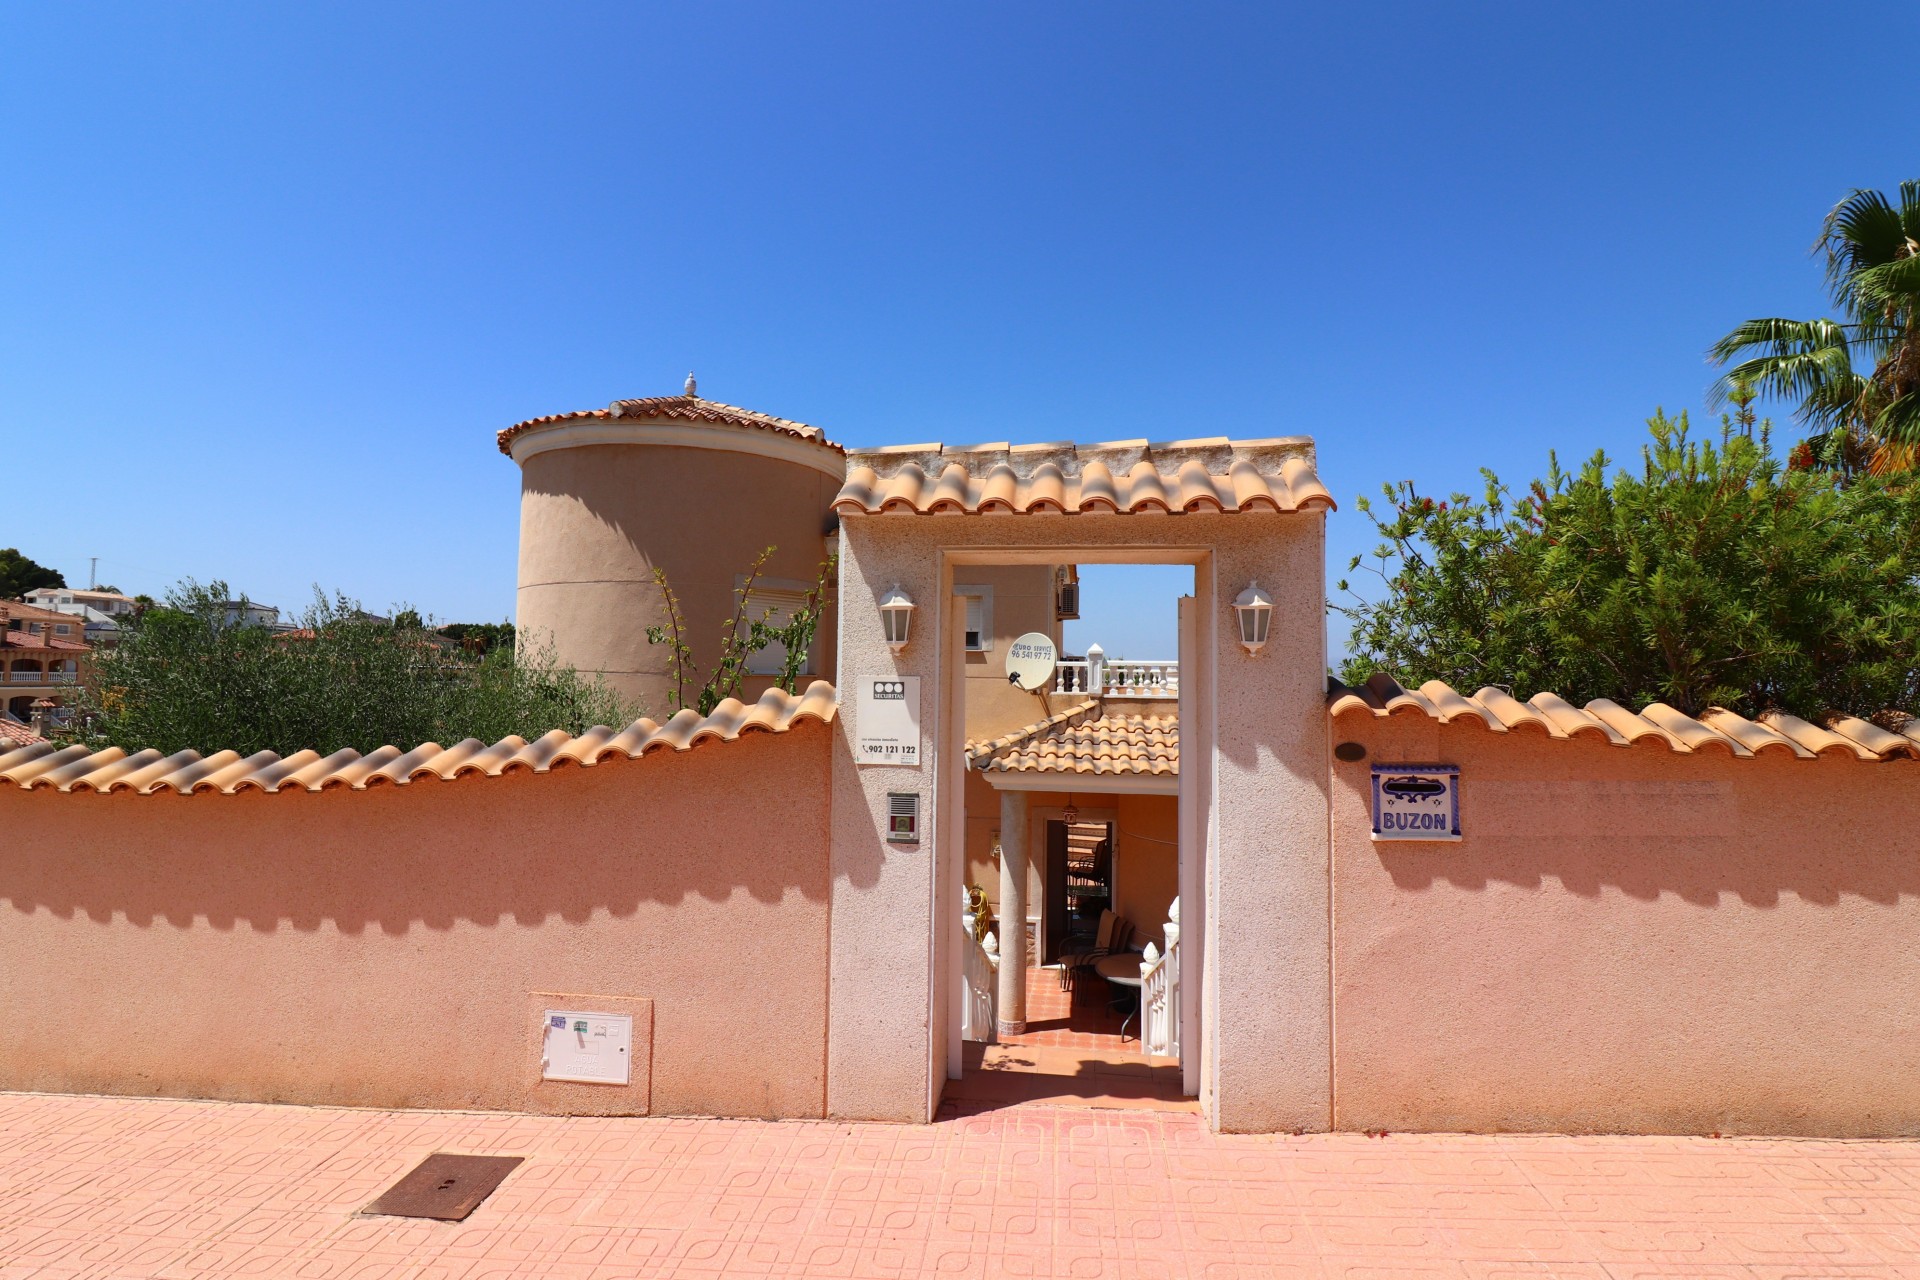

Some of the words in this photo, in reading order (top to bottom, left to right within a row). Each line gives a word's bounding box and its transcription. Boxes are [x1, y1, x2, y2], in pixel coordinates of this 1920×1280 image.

[1011, 650, 1020, 658] 96
[1021, 651, 1033, 659] 541
[1034, 652, 1042, 660] 97
[868, 745, 883, 753] 902
[886, 745, 898, 753] 121
[902, 746, 916, 754] 122
[1383, 812, 1446, 831] BUZON
[575, 1055, 599, 1065] AGUA
[566, 1064, 606, 1076] POTABLE
